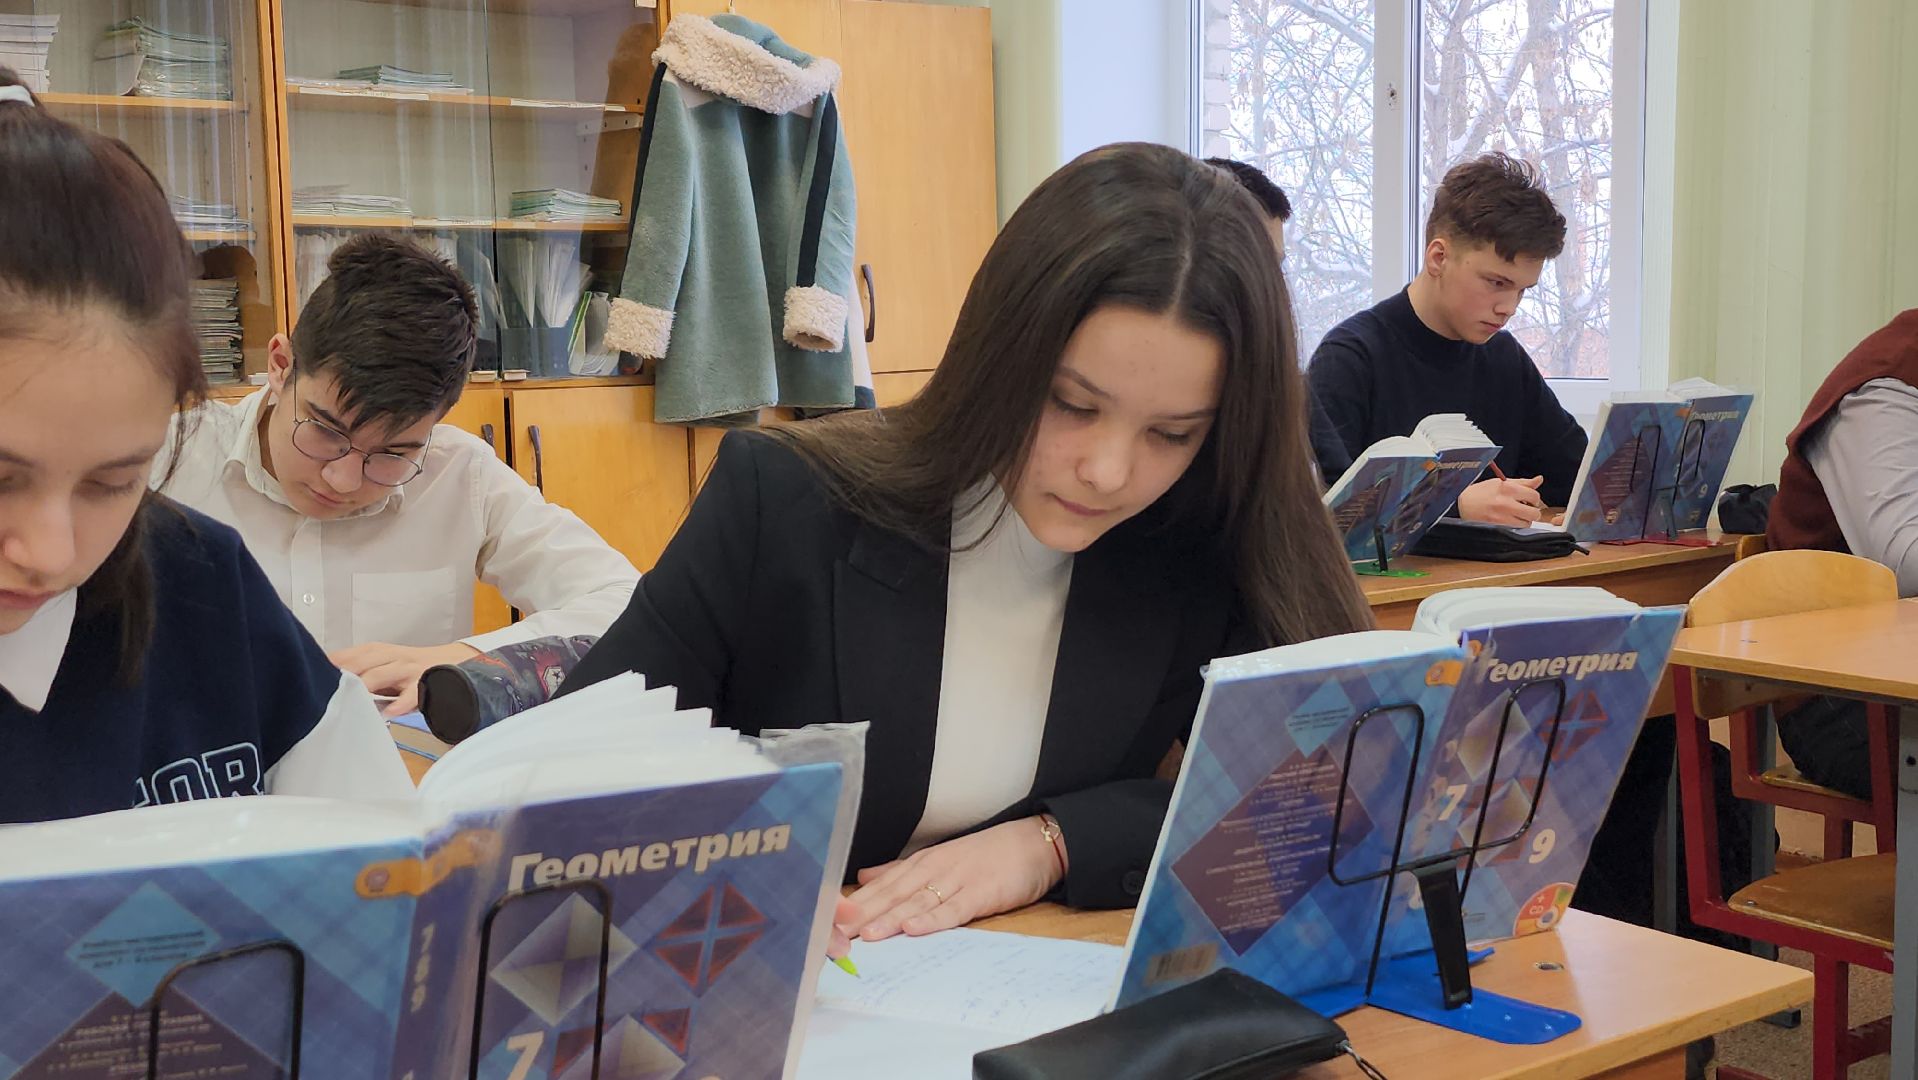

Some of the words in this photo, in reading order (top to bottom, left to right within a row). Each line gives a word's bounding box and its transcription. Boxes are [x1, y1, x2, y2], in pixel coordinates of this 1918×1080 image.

[1439, 783, 1468, 820] 7
[507, 824, 791, 893] Геометрия
[1529, 829, 1556, 864] 9
